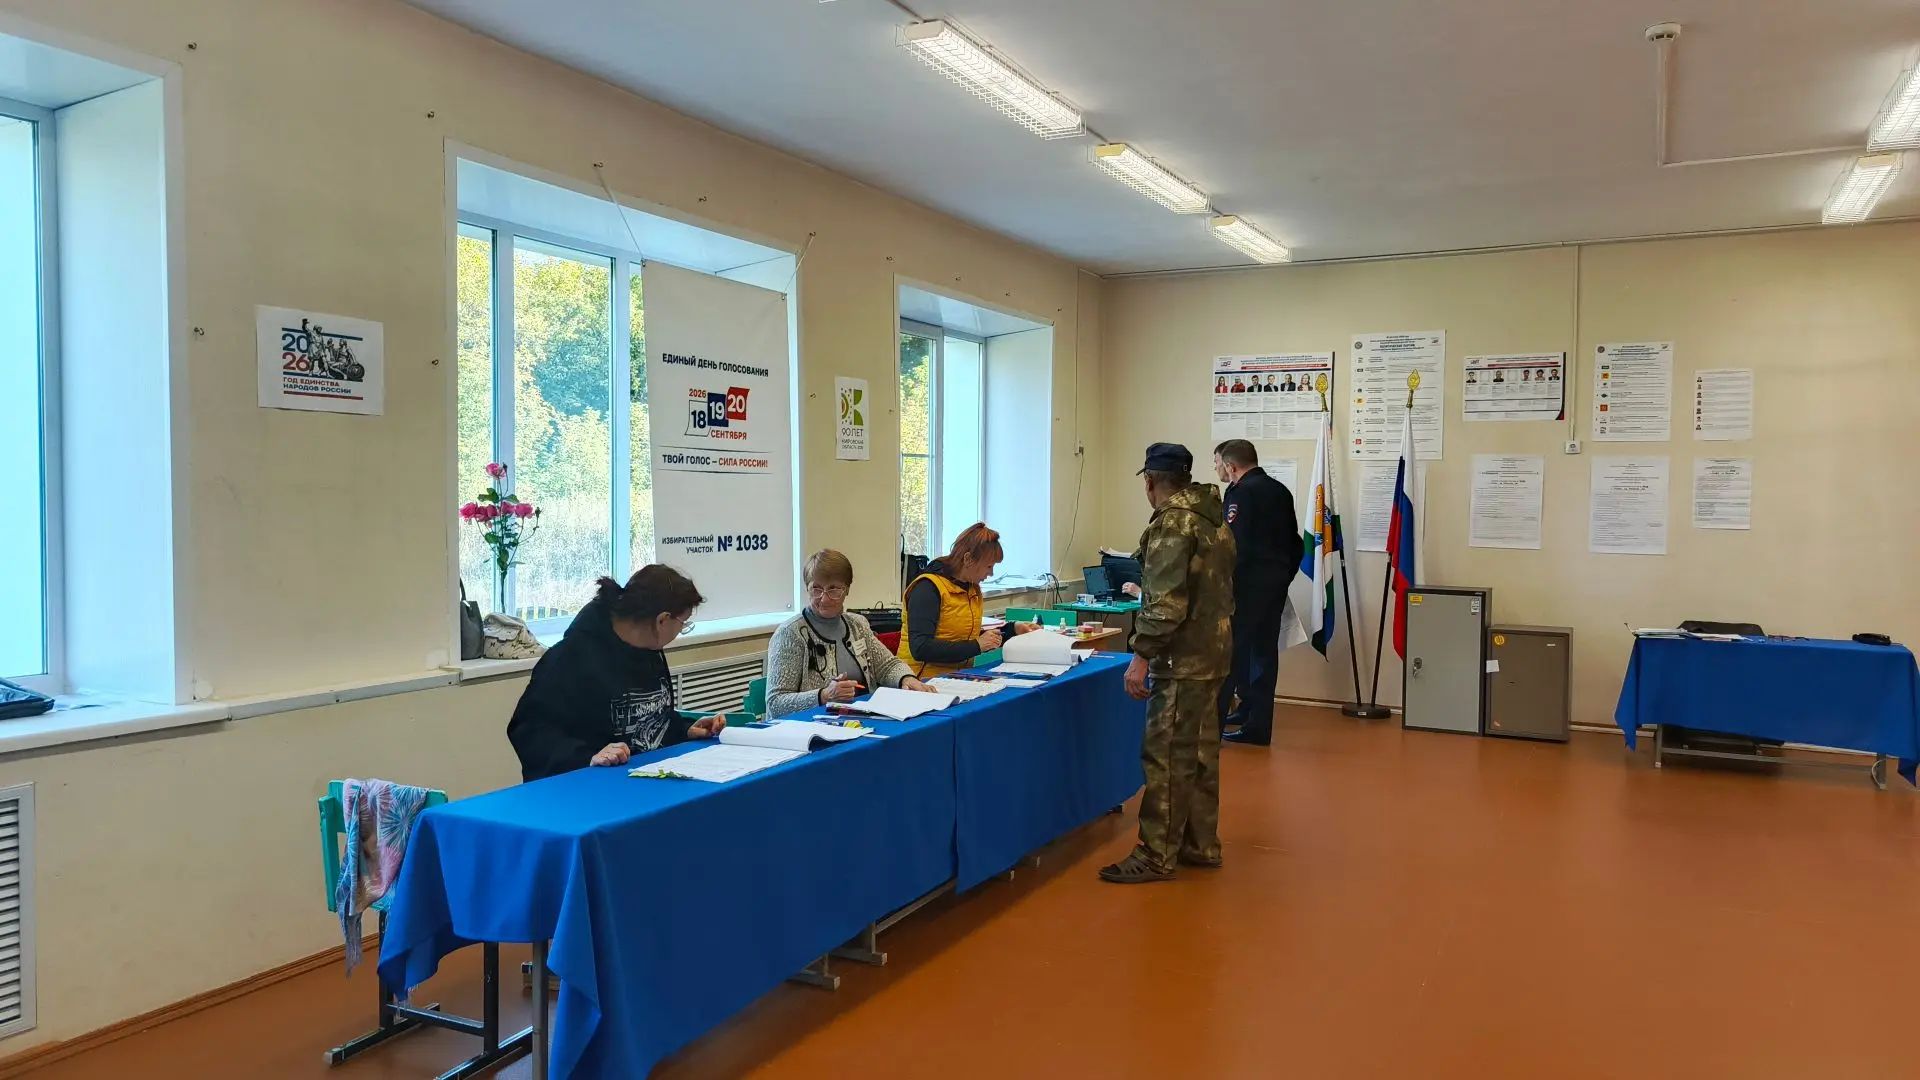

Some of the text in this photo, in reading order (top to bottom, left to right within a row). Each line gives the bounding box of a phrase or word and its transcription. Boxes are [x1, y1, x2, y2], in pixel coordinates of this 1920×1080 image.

[282, 333, 309, 353] 20
[282, 352, 310, 372] 26
[662, 353, 768, 377] ЕДИНЫЙ ДЕНЬ ГОЛОСОВАНИЯ
[300, 379, 340, 387] ЕДИНСТВА
[689, 388, 706, 398] 2026
[691, 394, 745, 429] 18 19 20
[711, 429, 747, 440] СЕНТЯБРЯ
[842, 428, 863, 436] 90 ЛЕТ
[662, 454, 684, 463] ТВОЙ
[686, 456, 711, 465] ГОЛОС
[719, 458, 738, 467] СИЛА
[739, 459, 768, 468] РОССИИ!
[662, 534, 714, 545] ИЗБИРАТЕЛЬНЫЙ
[717, 534, 768, 552] № 1038
[686, 546, 714, 554] УЧАСТОК
